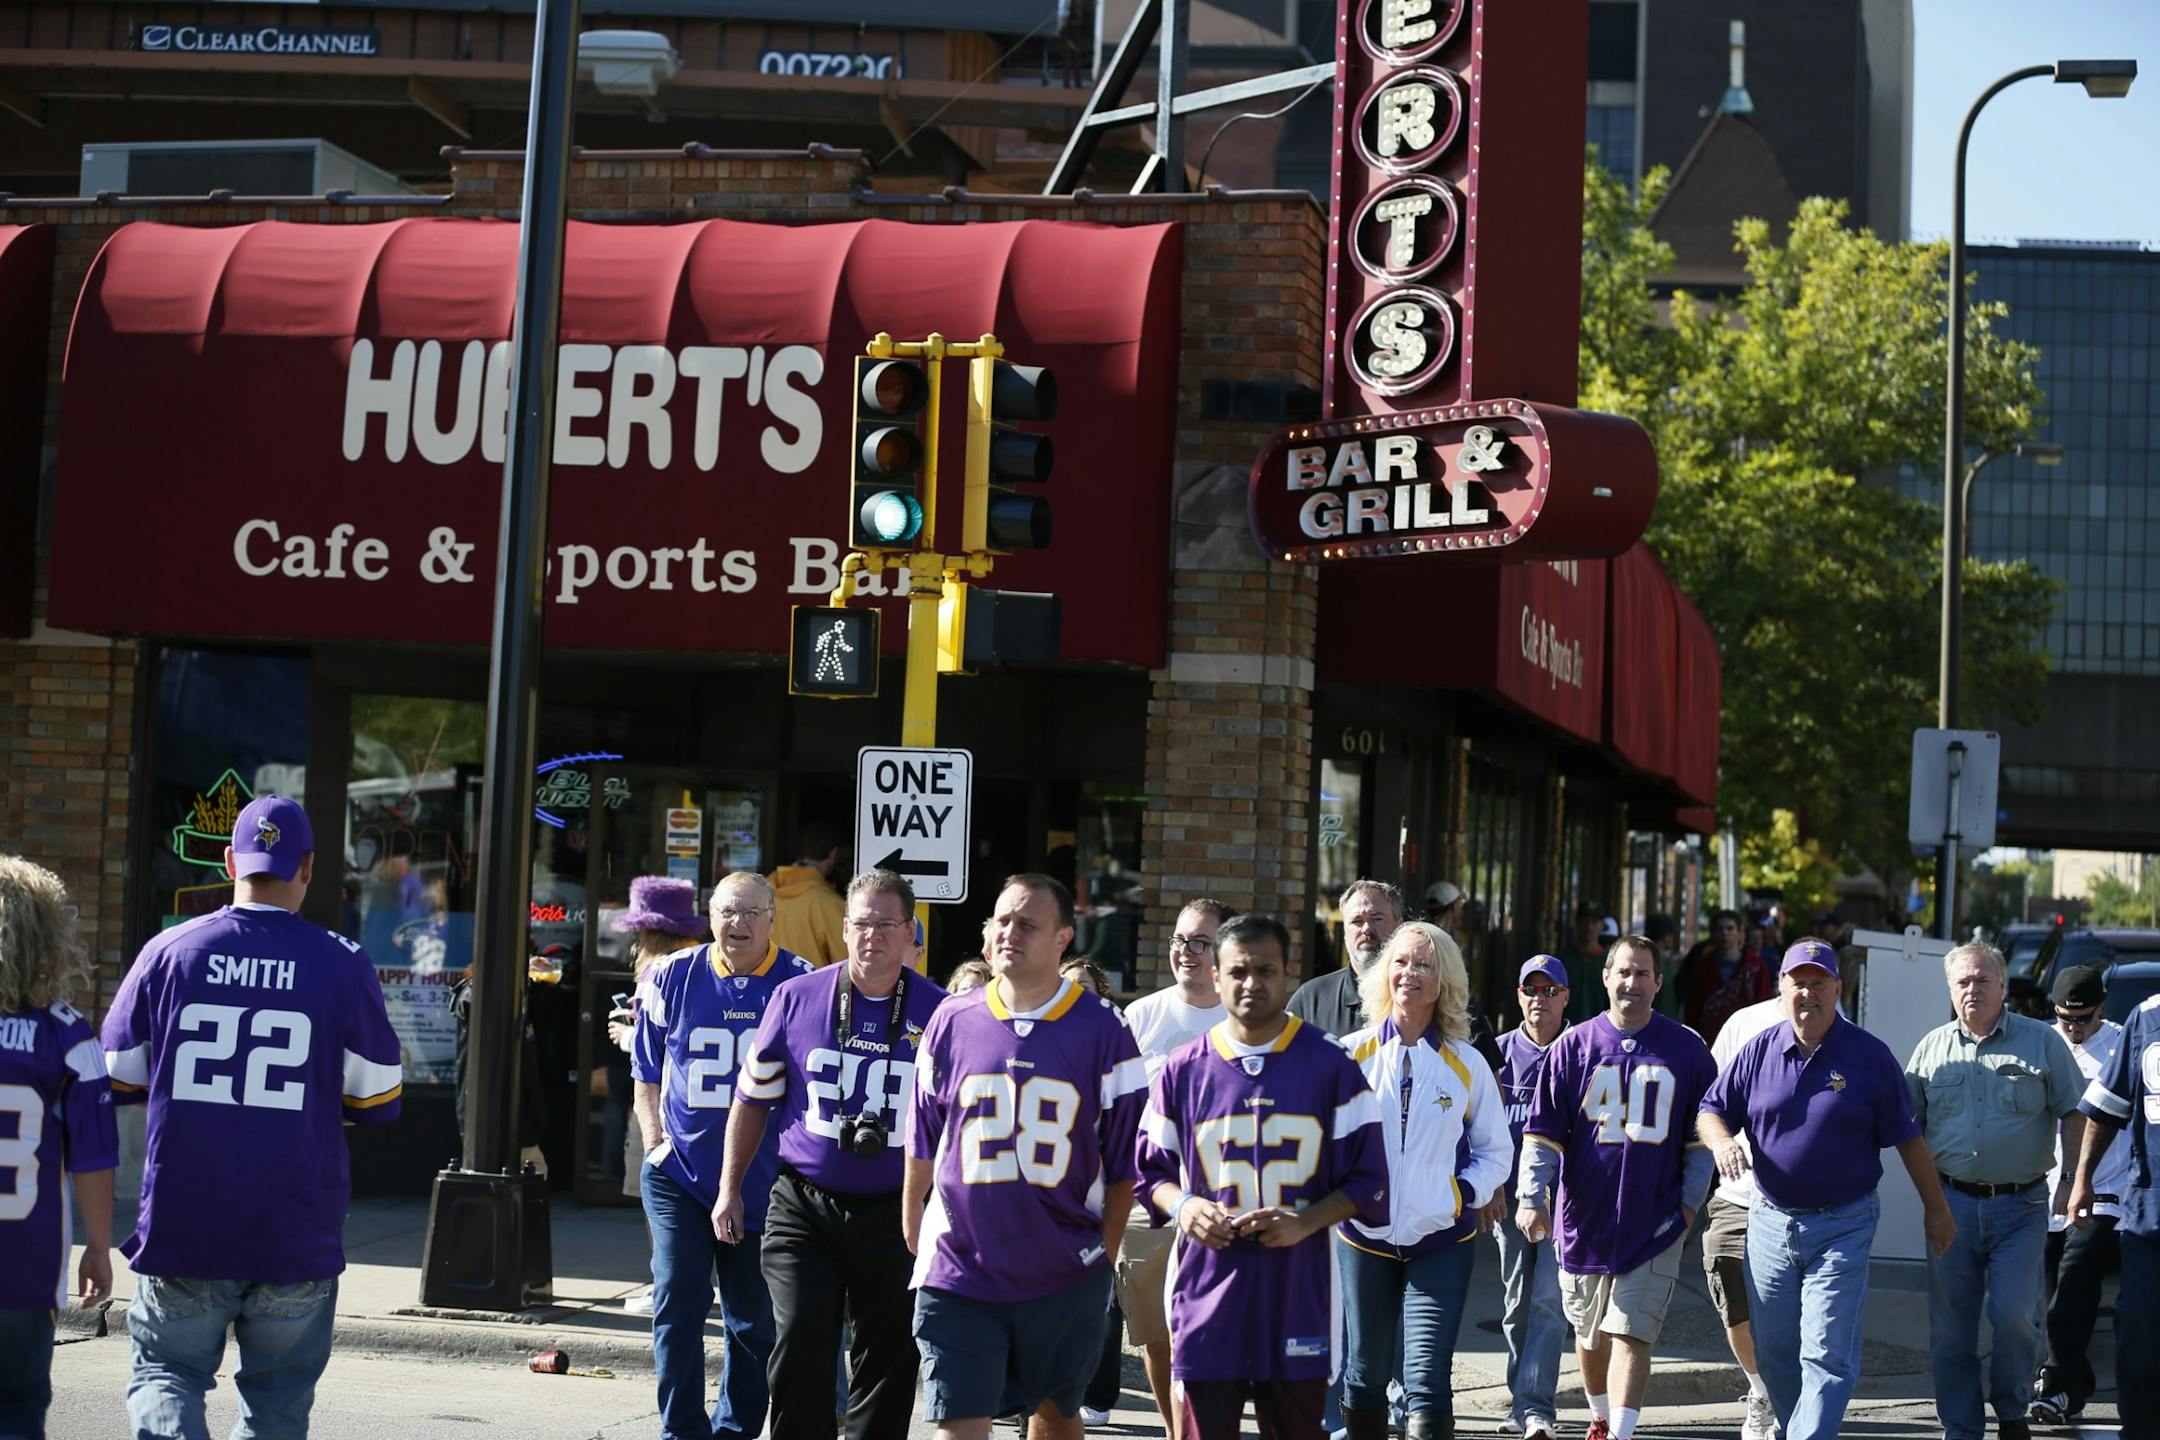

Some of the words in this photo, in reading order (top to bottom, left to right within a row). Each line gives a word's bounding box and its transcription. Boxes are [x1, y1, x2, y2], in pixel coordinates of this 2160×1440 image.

[1287, 434, 1419, 491] BAR
[1457, 424, 1505, 474] &
[1299, 480, 1489, 540] GRILL
[233, 519, 390, 581] Cafe
[420, 527, 475, 584] &
[545, 538, 757, 604] ports
[875, 760, 953, 794] ONE
[871, 804, 953, 838] WAY
[206, 954, 296, 990] SMITH
[0, 1015, 38, 1053] ON
[172, 1003, 312, 1111] 22
[688, 1027, 758, 1109] 2
[806, 1048, 917, 1148] 28
[959, 1073, 1082, 1189] 28
[1582, 1064, 1677, 1146] 40
